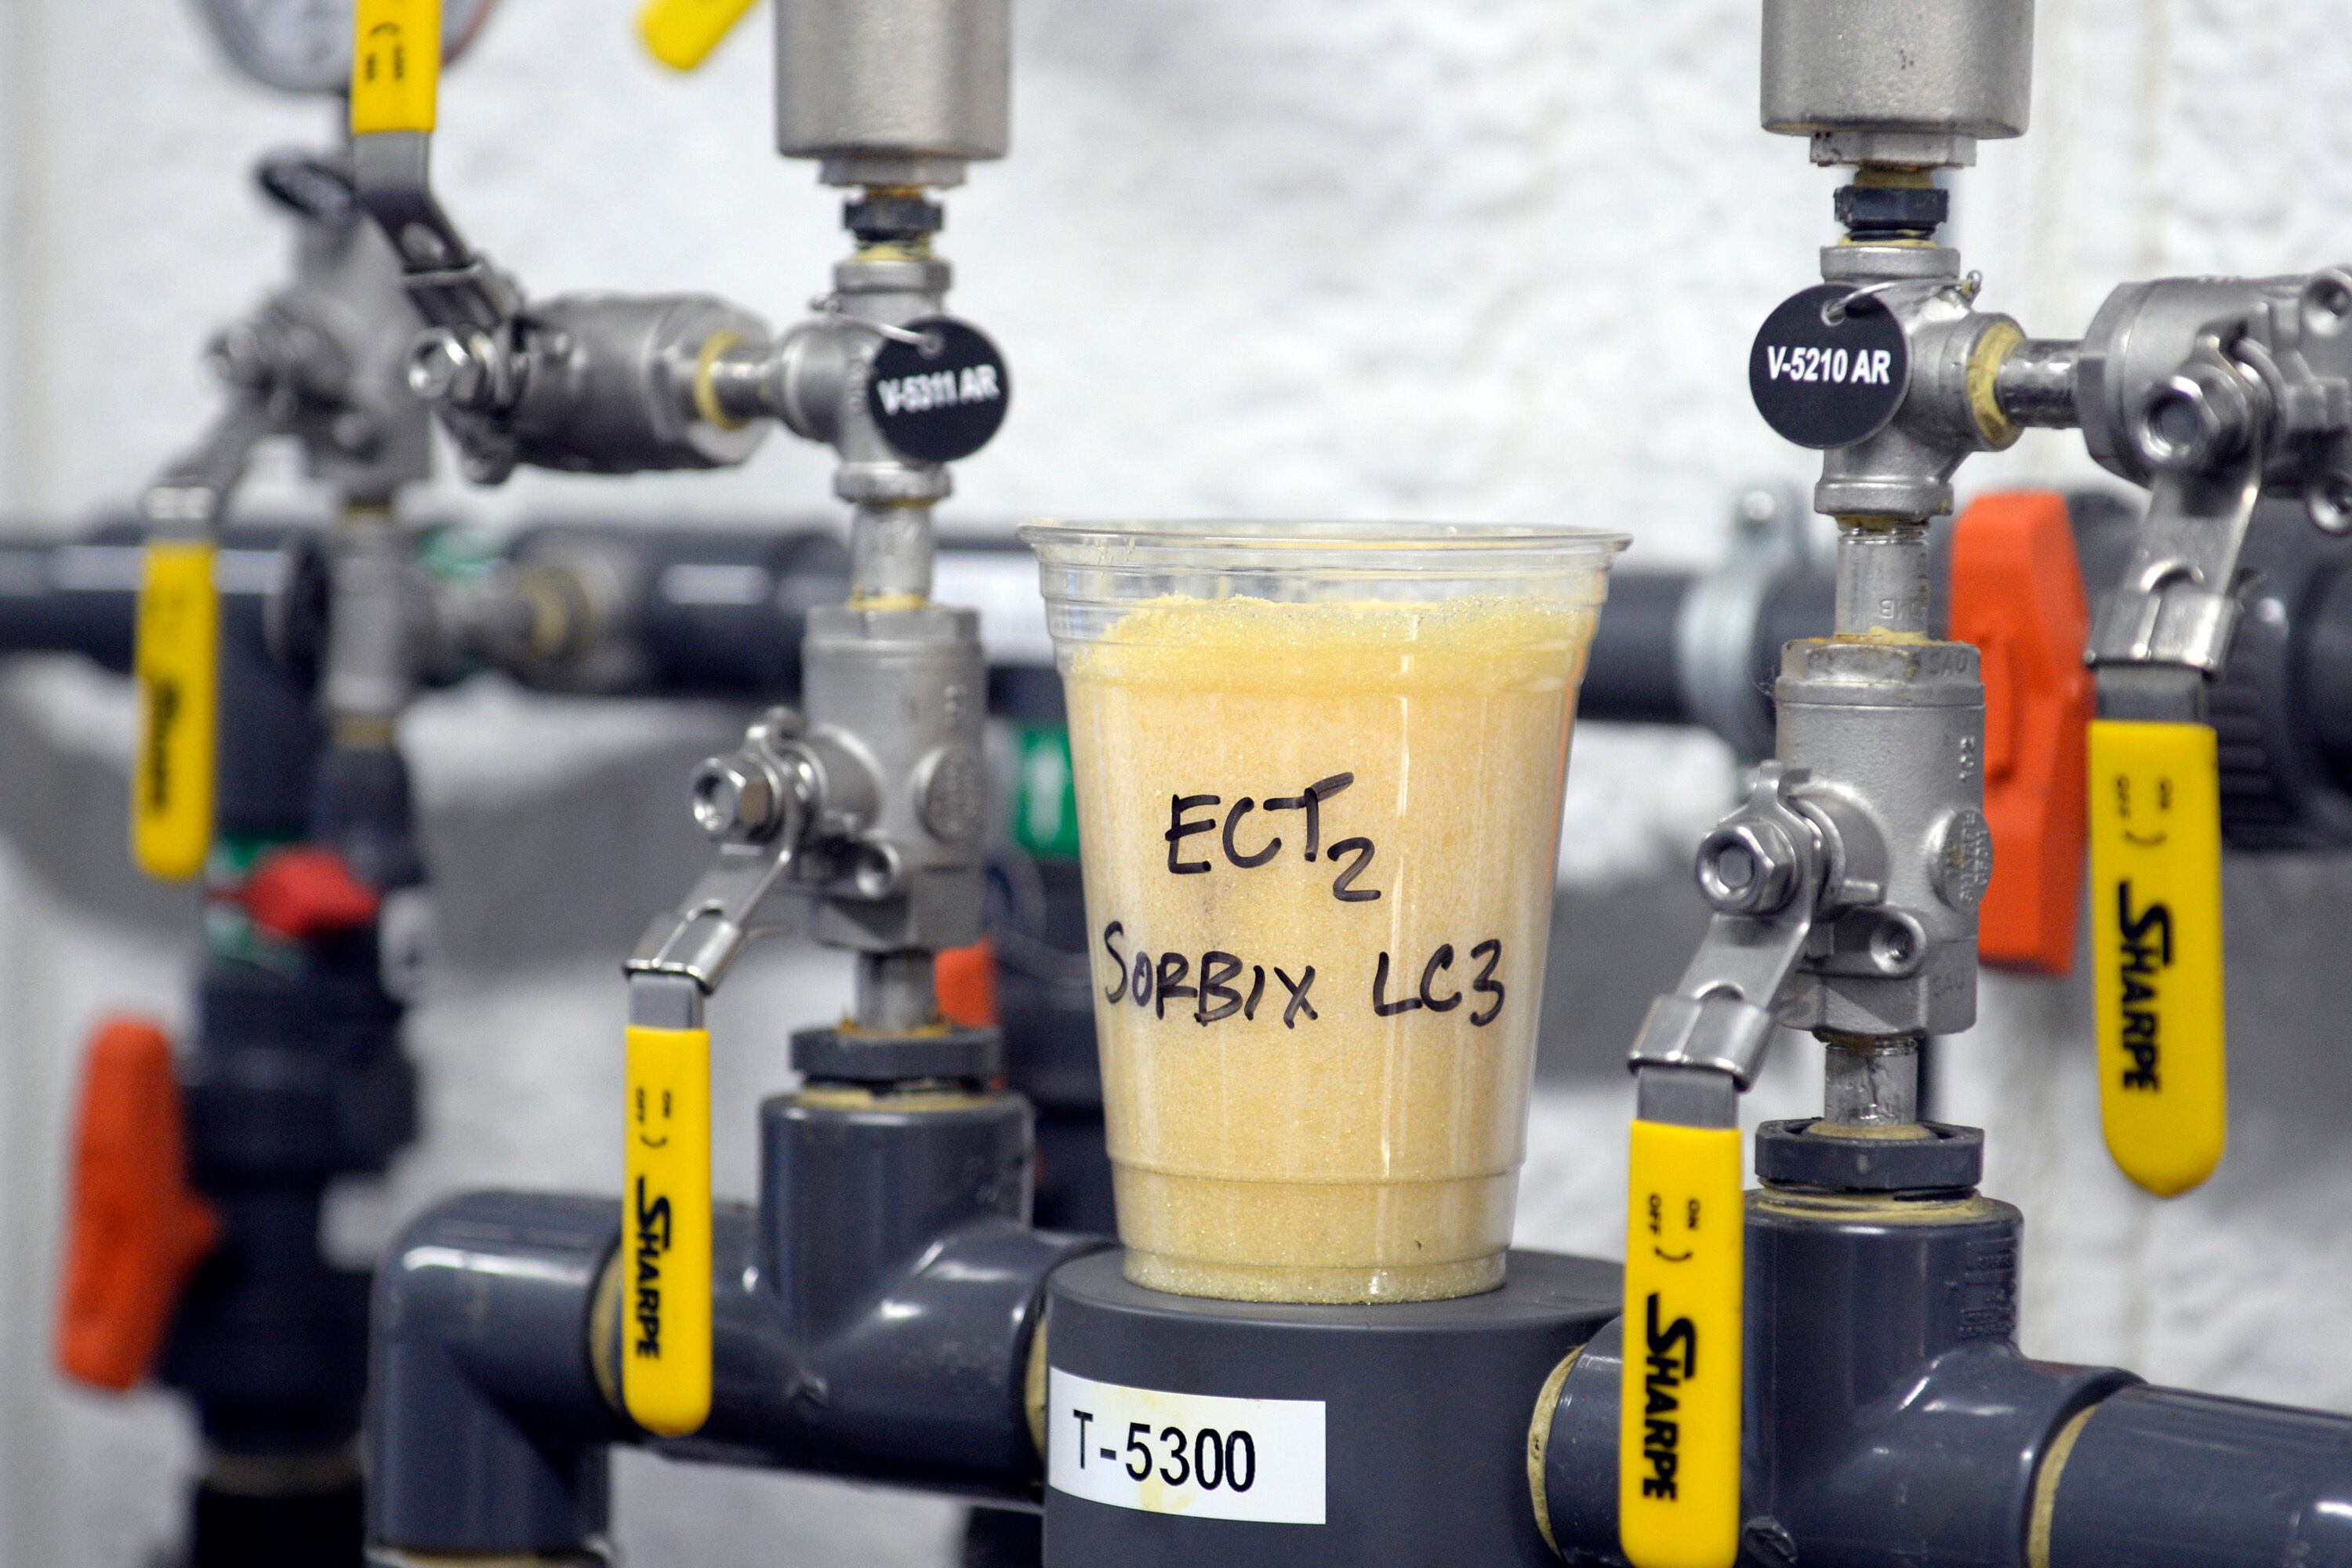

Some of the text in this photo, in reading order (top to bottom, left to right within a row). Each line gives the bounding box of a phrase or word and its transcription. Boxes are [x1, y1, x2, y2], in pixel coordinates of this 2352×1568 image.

[960, 363, 1000, 405] AR
[1767, 345, 1891, 385] V-5210 AR
[1372, 938, 1506, 1027] LC3
[2118, 879, 2174, 1093] SHARPE
[1649, 1193, 1661, 1236] OFF
[1687, 1198, 1701, 1230] ON
[636, 1175, 671, 1360] SHARPE
[1643, 1292, 1697, 1502] SHARPE
[1073, 1408, 1256, 1494] T-5300
